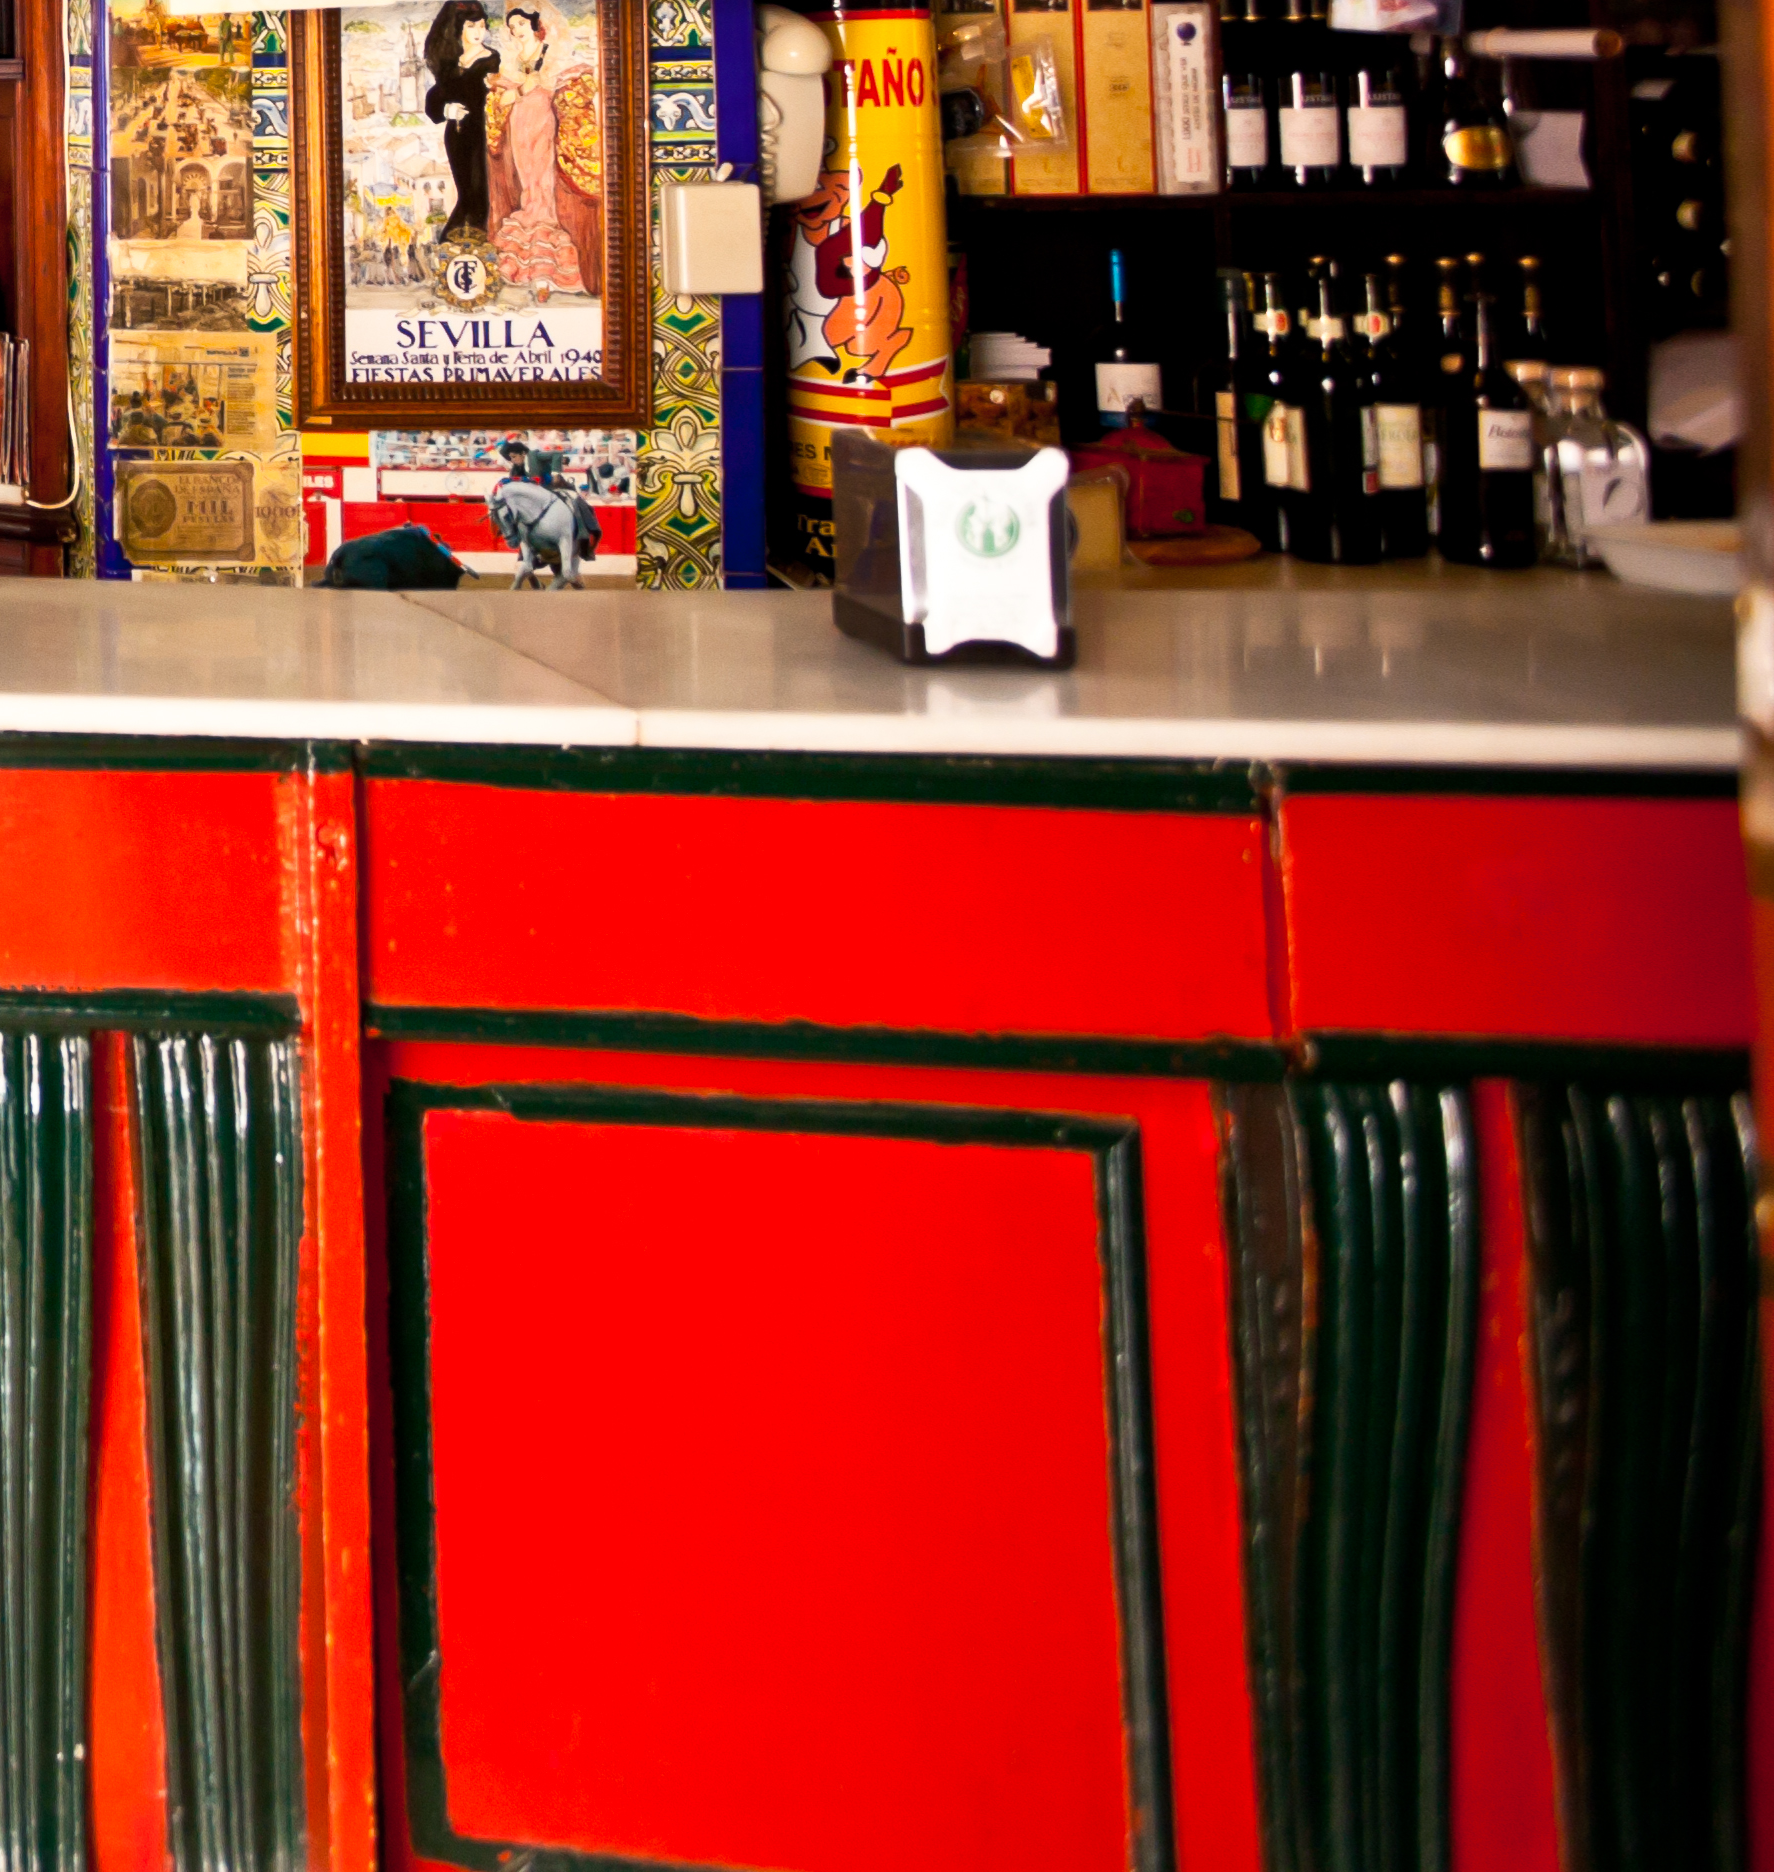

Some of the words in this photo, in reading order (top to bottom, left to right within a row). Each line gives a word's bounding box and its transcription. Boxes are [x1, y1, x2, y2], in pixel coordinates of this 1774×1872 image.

[396, 319, 556, 349] SEVILLA
[349, 350, 399, 366] Semana
[401, 350, 440, 366] Santa
[488, 350, 510, 366] de
[513, 349, 553, 366] Abril
[560, 348, 603, 368] 1940
[351, 367, 435, 383] FIESTAS
[443, 367, 603, 383] PRIMAVERALES
